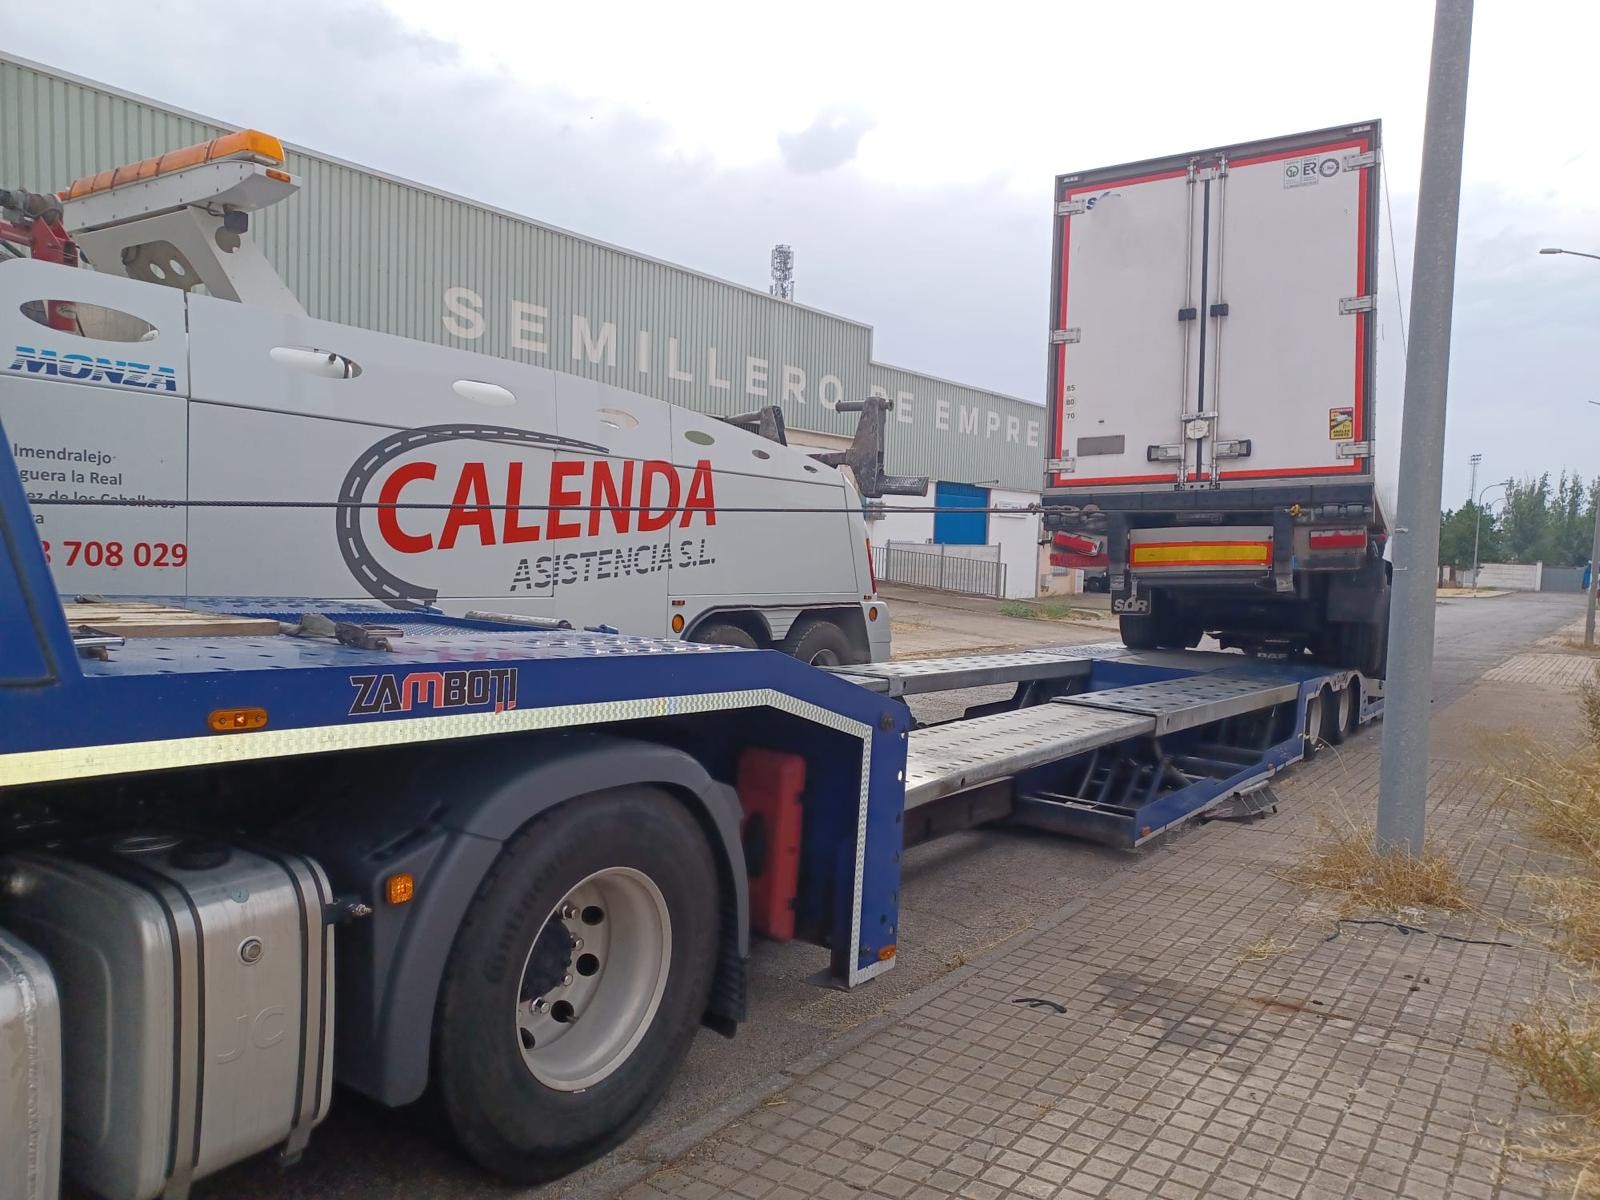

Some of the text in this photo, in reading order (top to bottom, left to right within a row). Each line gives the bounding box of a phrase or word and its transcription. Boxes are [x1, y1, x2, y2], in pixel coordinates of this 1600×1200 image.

[8, 345, 177, 391] MONZA
[441, 286, 845, 411] SEMILLERO
[935, 399, 1041, 448] EMPRE
[13, 443, 112, 466] lmendralejo
[20, 469, 122, 486] guera la Real
[377, 459, 717, 554] CALENDA
[63, 541, 123, 567] 708
[133, 542, 188, 567] 029
[509, 539, 716, 592] ASISTENCIA S.L.
